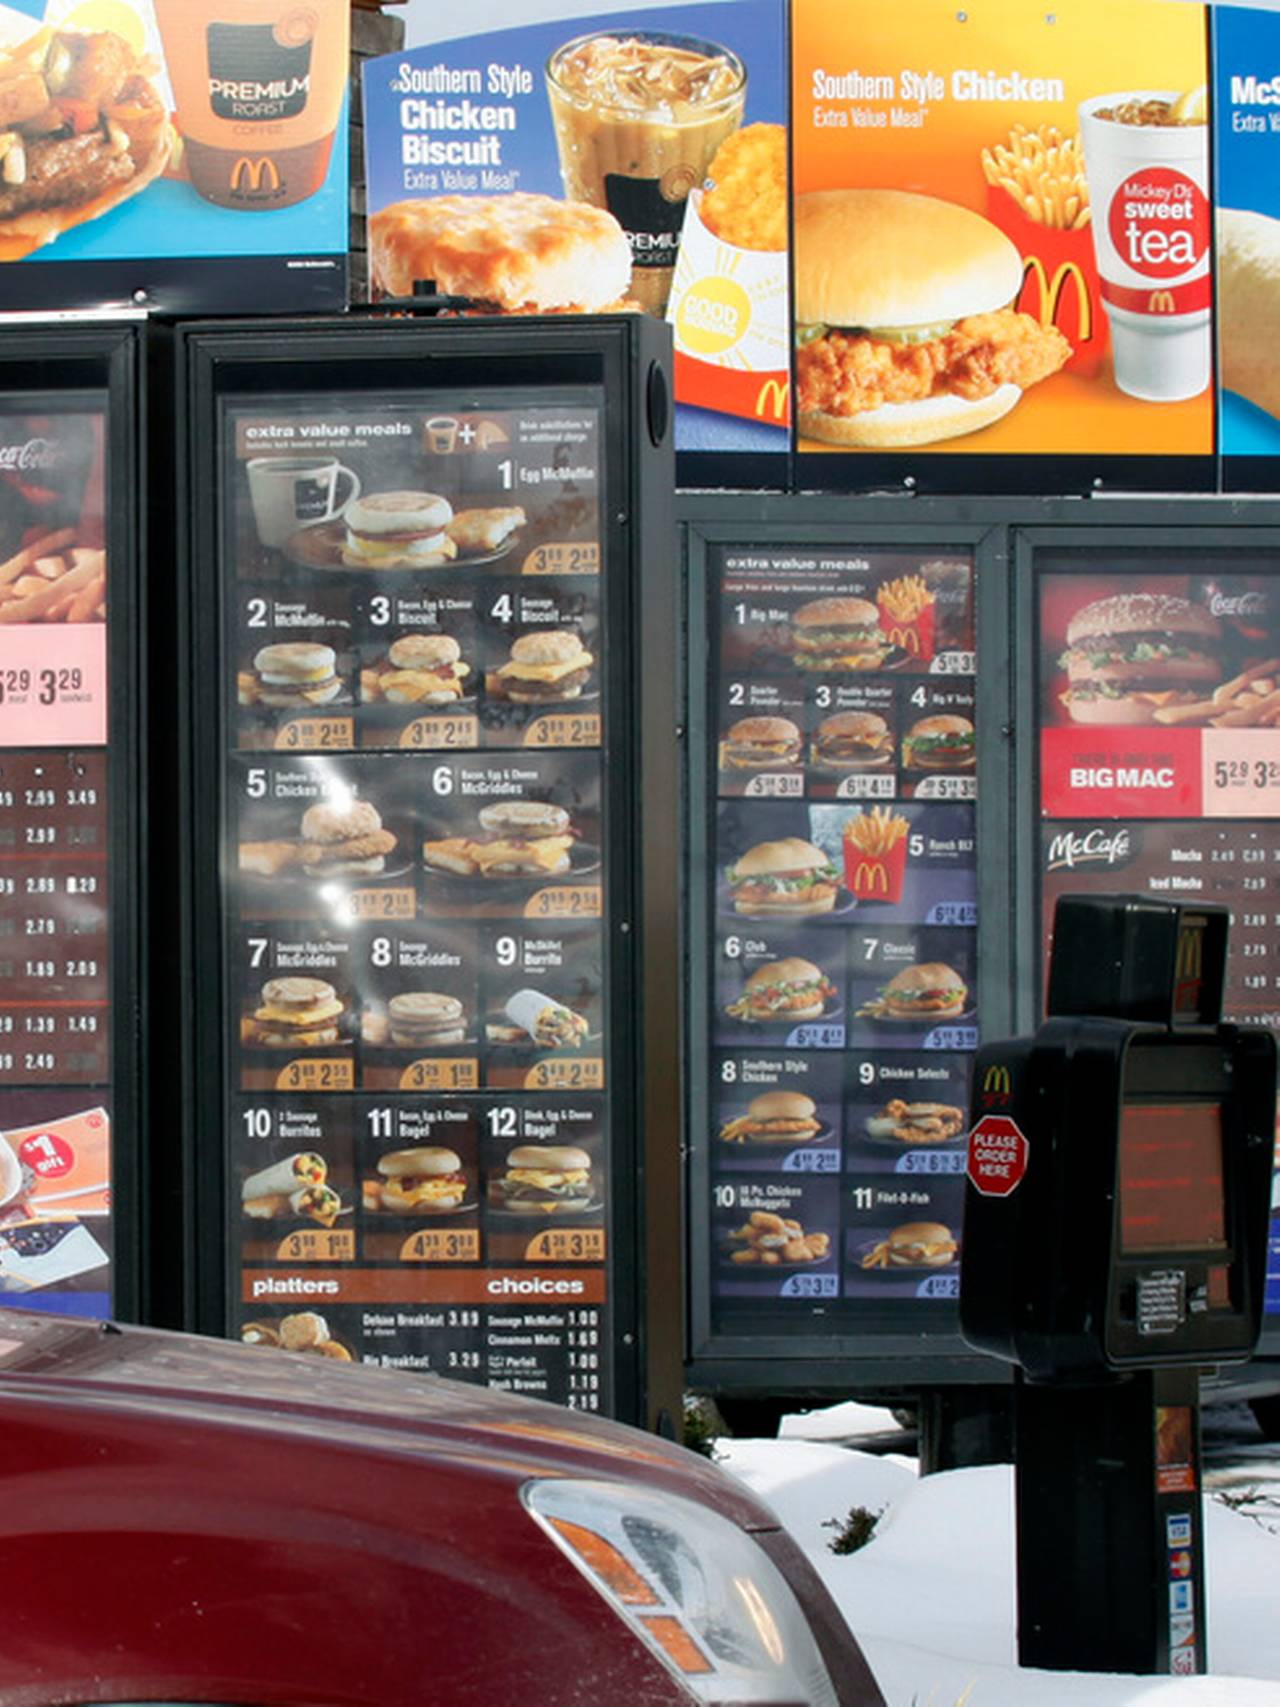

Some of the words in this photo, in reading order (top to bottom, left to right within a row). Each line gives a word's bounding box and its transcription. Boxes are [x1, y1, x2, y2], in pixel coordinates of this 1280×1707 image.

[208, 75, 311, 101] PREMIUM
[399, 63, 481, 93] Southern
[487, 63, 532, 99] Style
[812, 69, 894, 99] Southern
[900, 70, 945, 104] Style
[952, 70, 1064, 101] Chicken
[232, 101, 287, 117] ROAST
[400, 100, 517, 130] Chicken
[814, 107, 848, 127] Extra
[851, 107, 887, 127] Value
[1233, 111, 1266, 132] Extra
[402, 135, 502, 165] Biscuit
[404, 168, 438, 190] Extra
[441, 169, 478, 190] Value
[1124, 184, 1169, 201] Mickey
[1124, 201, 1193, 219] sweet
[1125, 221, 1197, 263] tea
[684, 297, 738, 325] GOOD
[245, 426, 294, 438] extra
[299, 425, 349, 437] value
[354, 424, 412, 436] meals
[497, 460, 512, 489] 1
[520, 468, 540, 483] Egg
[542, 466, 595, 481] McMuffin
[727, 559, 768, 571] extra
[771, 558, 816, 571] value
[820, 558, 870, 571] meals
[247, 599, 267, 628] 2
[371, 598, 390, 625] 3
[398, 613, 437, 624] Biscuit
[491, 595, 512, 623] 4
[521, 610, 559, 622] Biscuit
[734, 603, 746, 625] 1
[729, 683, 745, 706] 2
[816, 686, 831, 708] 3
[911, 686, 926, 708] 4
[247, 769, 266, 797] 5
[433, 766, 453, 795] 6
[1071, 768, 1113, 788] BIG
[1117, 768, 1174, 788] MAC
[275, 784, 317, 797] Chicken
[909, 834, 924, 856] 5
[1171, 849, 1202, 862] Mocha
[1172, 877, 1203, 889] Mocha
[248, 939, 267, 967] 7
[372, 938, 391, 966] 8
[496, 937, 516, 965] 9
[725, 936, 740, 958] 6
[863, 938, 878, 960] 7
[524, 953, 562, 966] Burrito
[722, 1060, 737, 1082] 8
[859, 1062, 874, 1085] 9
[243, 1108, 270, 1137] 10
[368, 1108, 392, 1136] 11
[399, 1123, 430, 1138] Bagel
[488, 1107, 516, 1136] 12
[524, 1123, 557, 1138] Bagel
[974, 1133, 1018, 1150] PLEASE
[36, 1157, 65, 1170] gift
[975, 1148, 1017, 1163] ORDER
[978, 1162, 1011, 1179] HERE
[713, 1185, 735, 1207] 10
[853, 1187, 872, 1209] 11
[253, 1276, 339, 1295] platters
[488, 1276, 585, 1294] choices
[363, 1313, 394, 1327] Deluxe
[397, 1312, 445, 1327] Breakfast
[487, 1334, 532, 1346] Cinnamon
[535, 1332, 561, 1345] Melts
[381, 1355, 429, 1368] Breakfast
